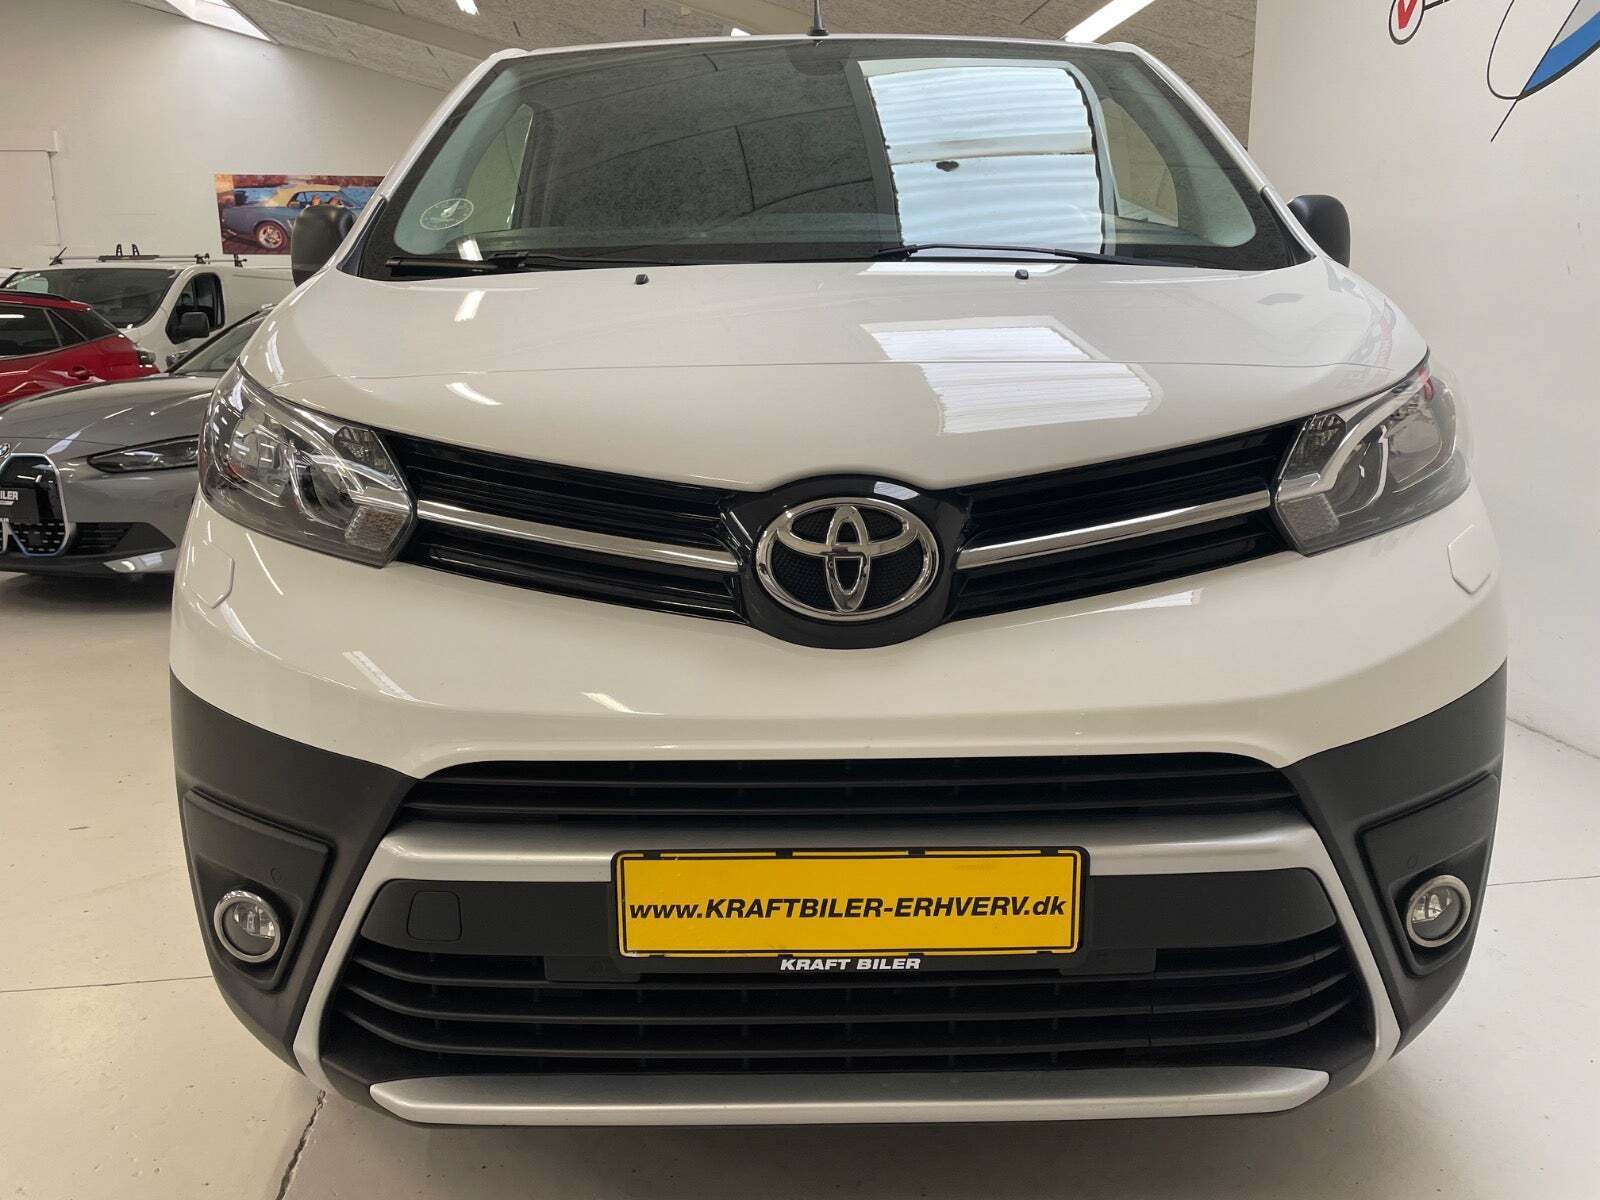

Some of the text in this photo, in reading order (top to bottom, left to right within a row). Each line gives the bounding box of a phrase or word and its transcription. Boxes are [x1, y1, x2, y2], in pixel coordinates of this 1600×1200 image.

[629, 896, 1067, 919] www.KRAFTBILER-ERHVERV.dk
[780, 958, 921, 971] KRAFT BILER
